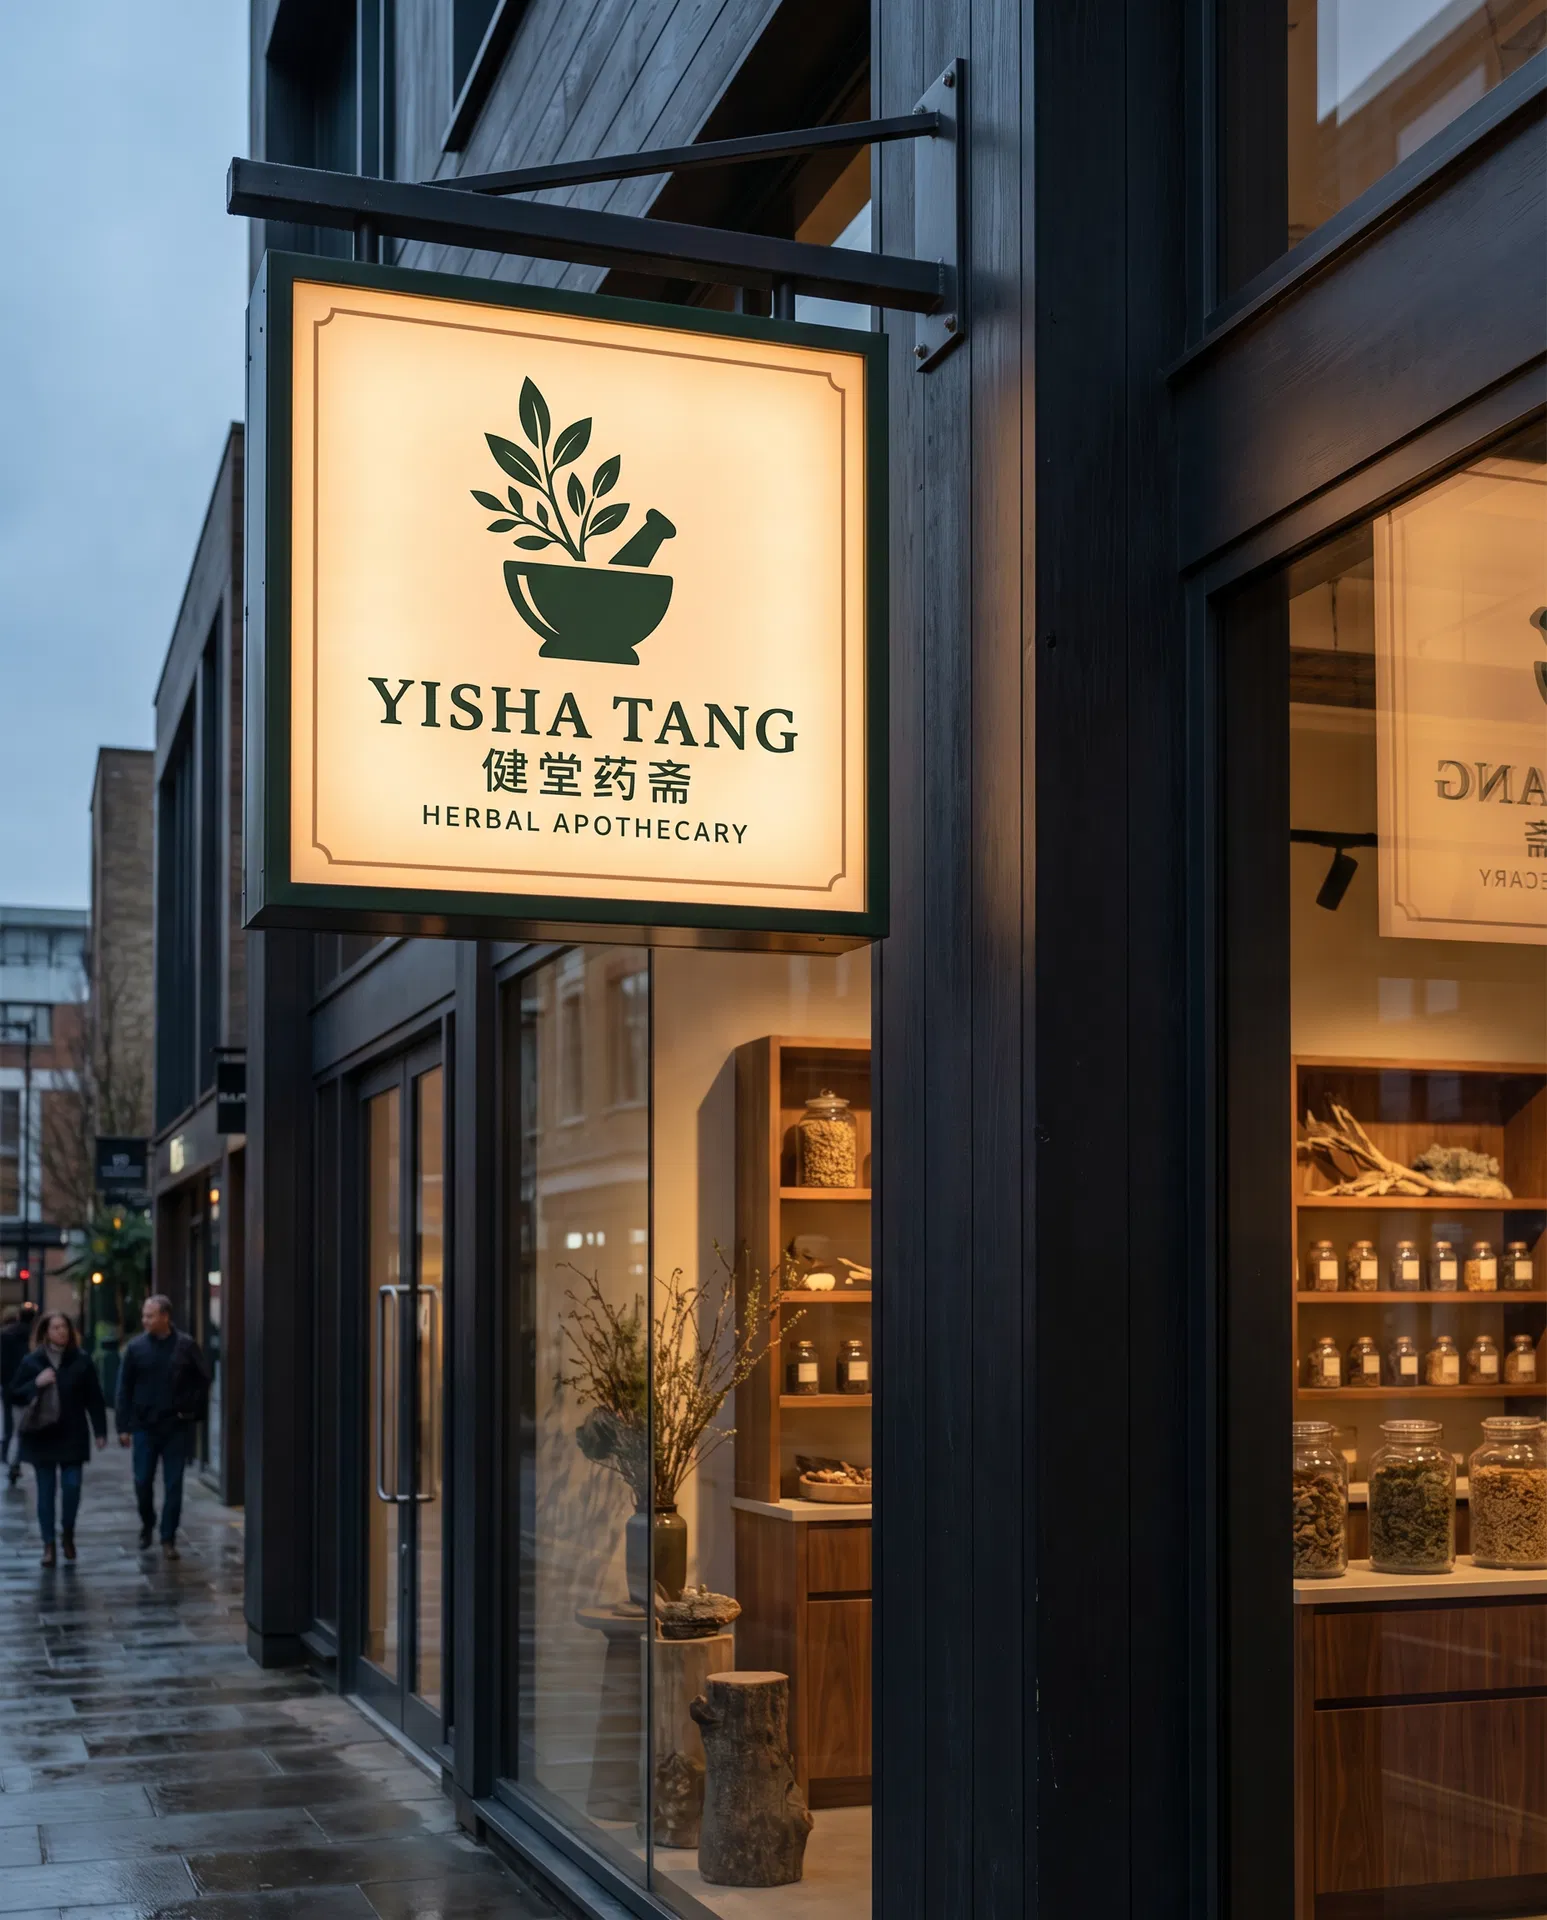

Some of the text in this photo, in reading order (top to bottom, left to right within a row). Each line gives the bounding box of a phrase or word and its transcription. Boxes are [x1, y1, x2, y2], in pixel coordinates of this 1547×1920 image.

[367, 676, 799, 754] YISHA TANG
[482, 747, 691, 805] 健堂药斋
[423, 804, 748, 844] HERBAL APOTHECARY
